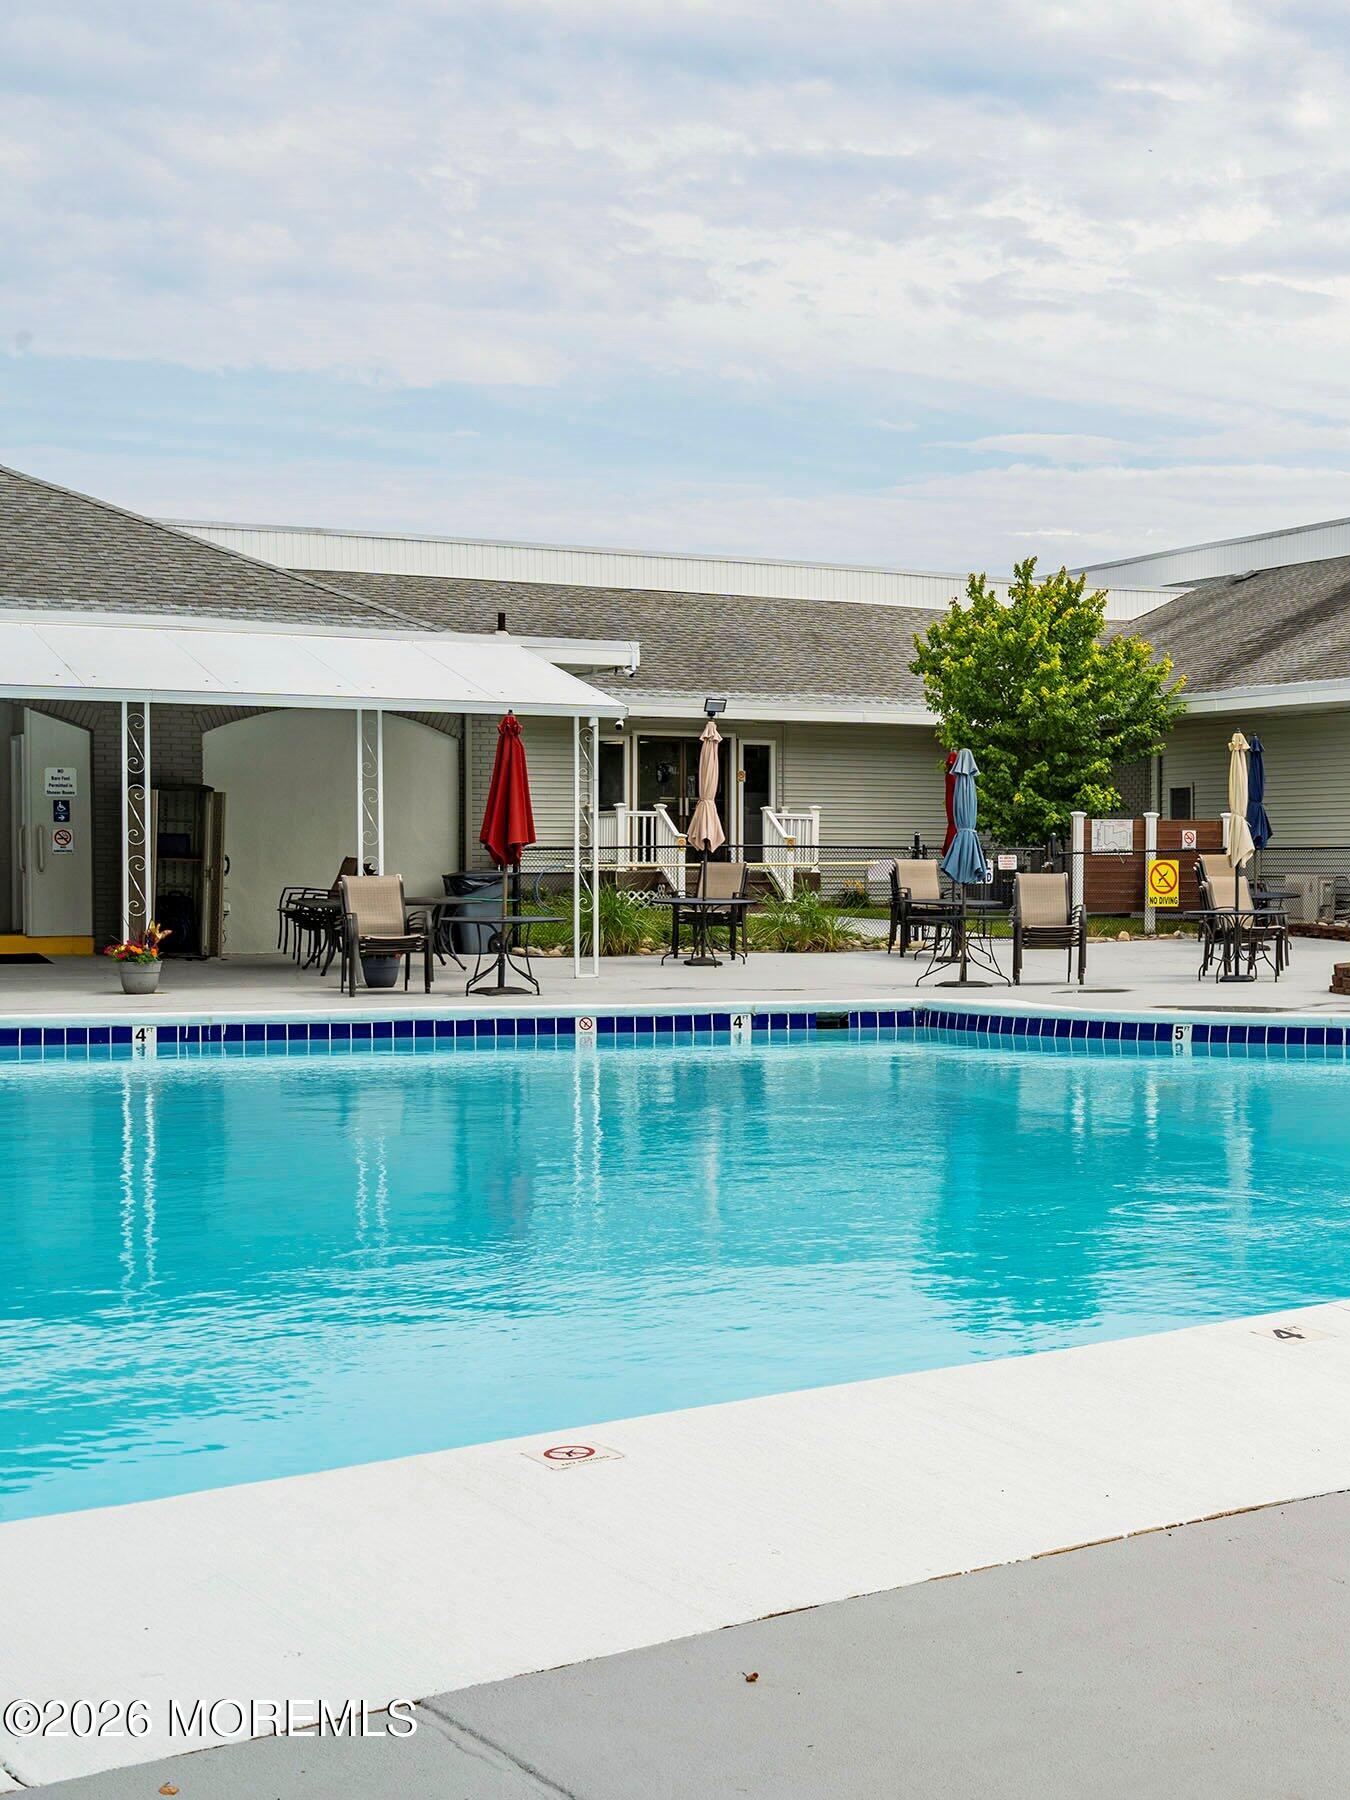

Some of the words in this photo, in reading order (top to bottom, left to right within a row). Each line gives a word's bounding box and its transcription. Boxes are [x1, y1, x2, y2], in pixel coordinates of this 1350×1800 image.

[733, 1015, 743, 1028] 4
[135, 1028, 146, 1042] 4
[1175, 1026, 1184, 1040] 5
[1272, 1329, 1306, 1339] 4
